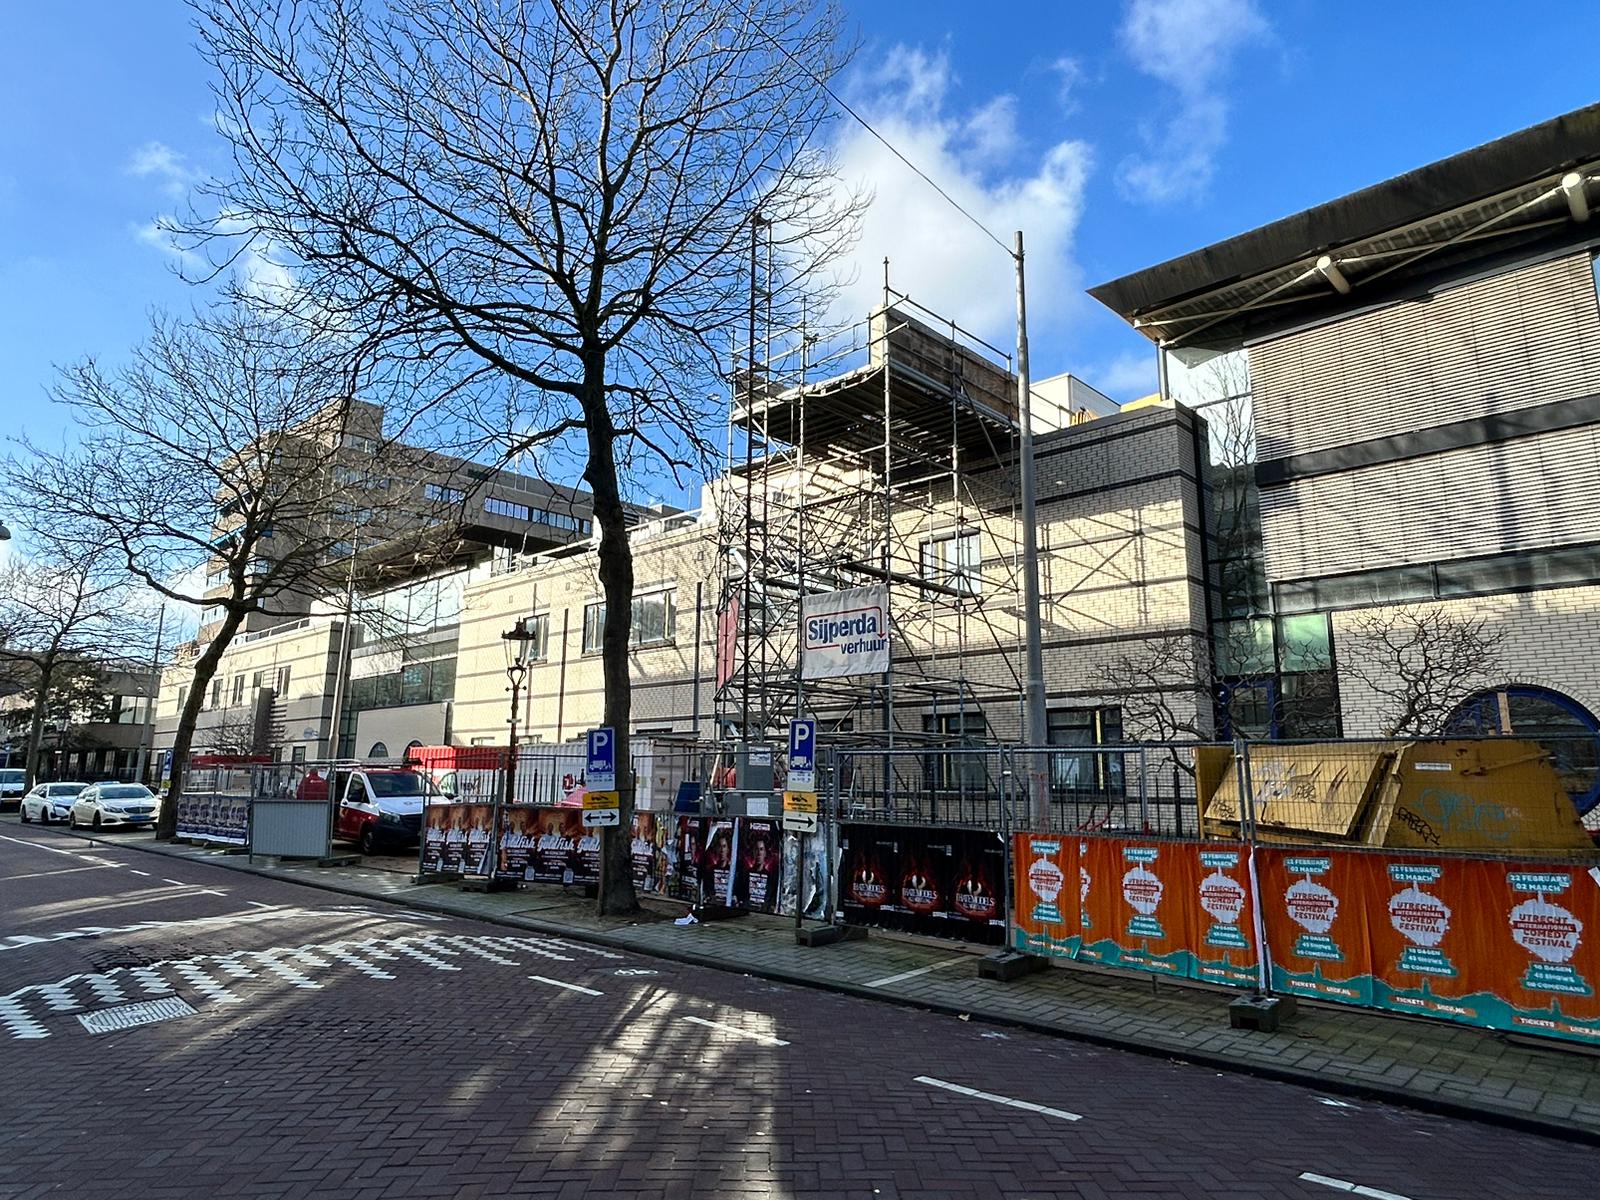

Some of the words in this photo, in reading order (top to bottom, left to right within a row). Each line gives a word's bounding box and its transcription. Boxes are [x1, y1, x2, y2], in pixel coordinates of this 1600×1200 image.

[808, 613, 877, 644] Sijperda
[840, 638, 887, 654] verhuur
[794, 724, 810, 750] P
[592, 732, 608, 756] P
[1529, 884, 1560, 892] MARCH
[1292, 892, 1328, 900] UTRECHT
[1207, 902, 1238, 911] FESTIVAL
[1396, 902, 1438, 911] UTRECHT
[1294, 912, 1330, 921] FESTIVAL
[1395, 910, 1442, 918] INTERNATIONAL
[1520, 914, 1568, 924] UTRECHT
[1400, 916, 1438, 926] COMEDY
[1399, 923, 1441, 933] FESTIVAL
[1517, 922, 1573, 931] INTERNATIONAL
[1523, 930, 1568, 939] COMEDY
[1522, 937, 1572, 948] FESTIVAL
[1411, 964, 1452, 974] COMEDIANS
[1544, 964, 1572, 973] DAGEN
[1544, 973, 1575, 983] SHOWS
[1537, 982, 1585, 993] COMEDIANS
[1396, 996, 1424, 1006] TICKETS
[1520, 1017, 1554, 1028] TICKETS
